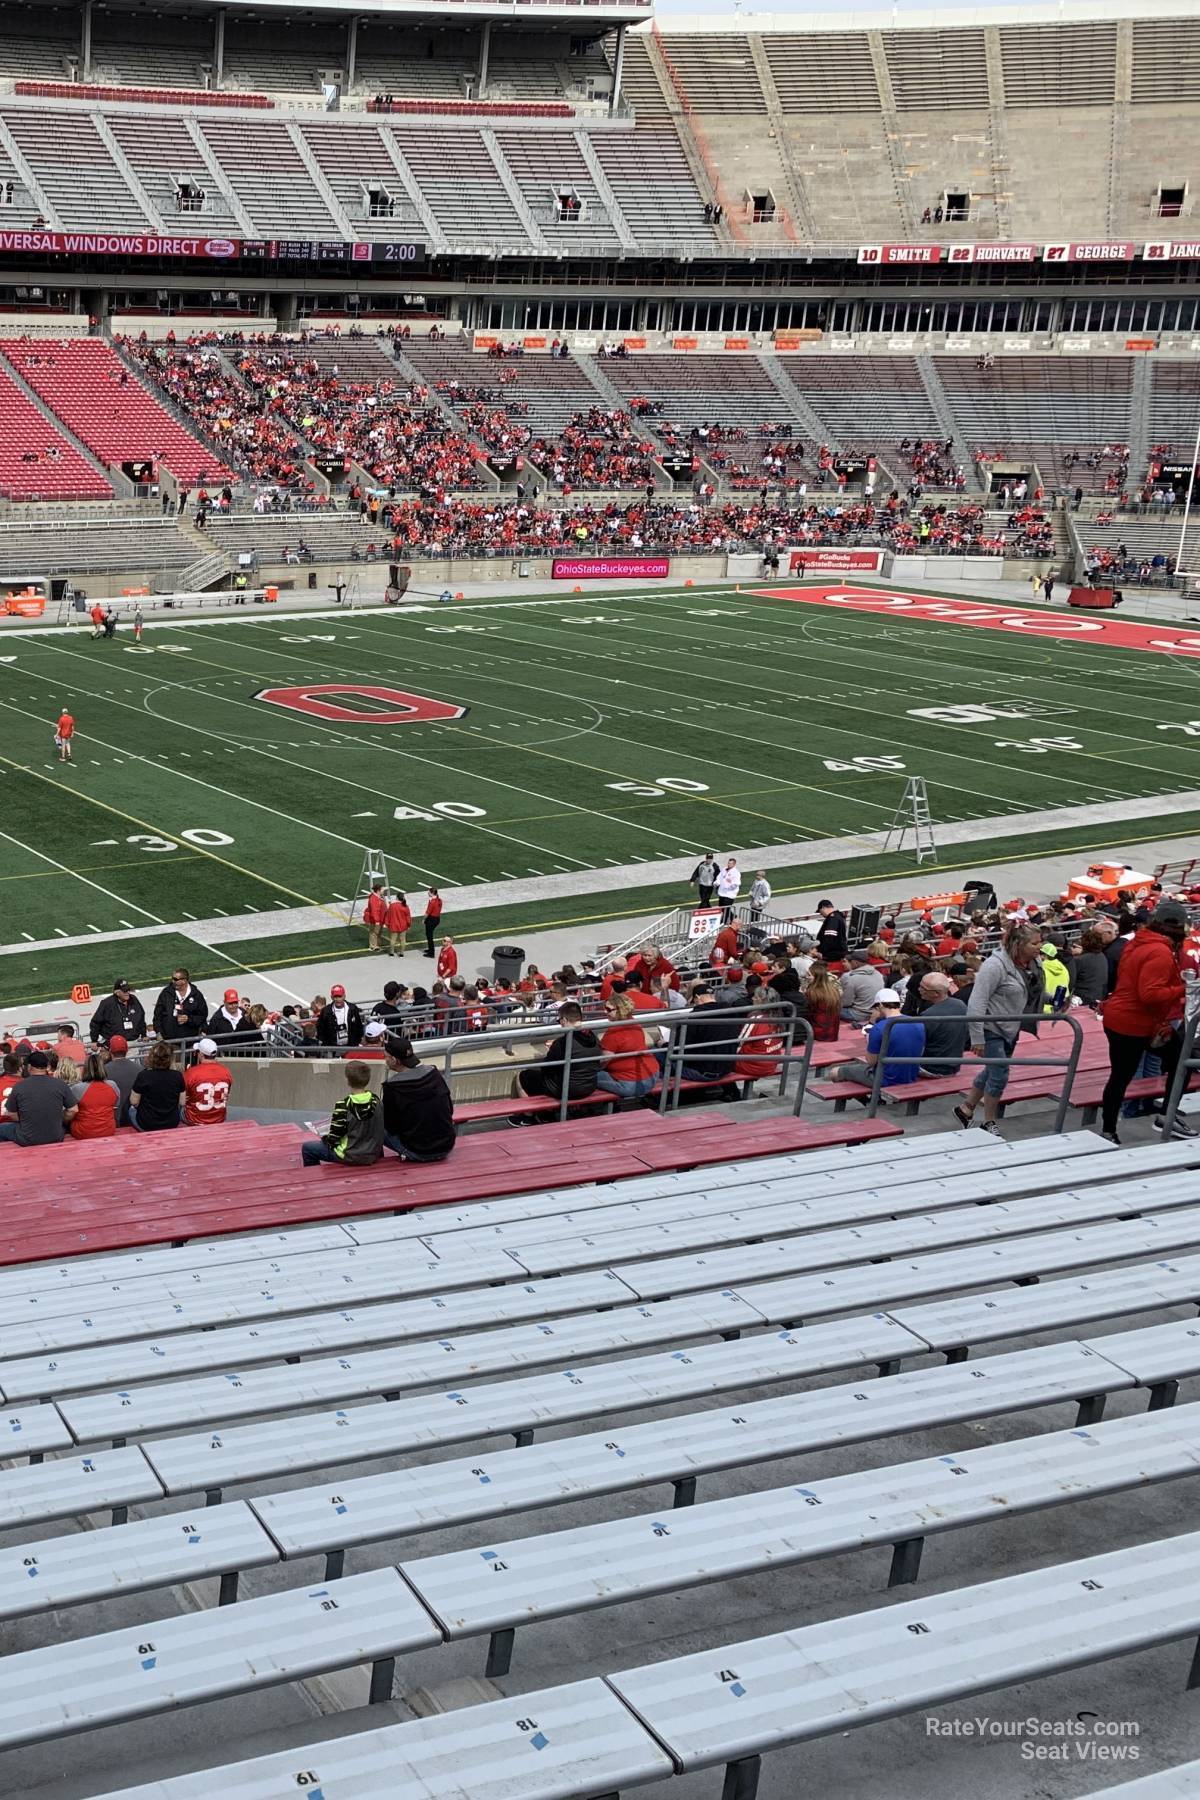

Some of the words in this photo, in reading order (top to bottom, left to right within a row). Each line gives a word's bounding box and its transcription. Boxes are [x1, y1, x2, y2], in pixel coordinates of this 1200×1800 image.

[64, 235, 143, 253] WINDOWS
[147, 238, 199, 255] DIRECT
[385, 245, 416, 260] 2:00
[862, 249, 878, 261] 10
[888, 248, 931, 261] SMITH
[952, 249, 970, 260] 22
[975, 247, 1031, 260] HORVATH
[1047, 247, 1065, 260] 27
[1075, 246, 1126, 259] GEORGE
[555, 564, 667, 575] OhioStateBuckeyes.com
[824, 594, 1106, 631] OHIO
[994, 738, 1084, 753] 30
[822, 755, 907, 773] 40
[606, 777, 710, 796] 50
[393, 801, 487, 822] 40
[125, 828, 236, 853] 30
[76, 986, 90, 1000] 20
[183, 1525, 196, 1533] 18
[495, 1562, 507, 1571] 17
[1081, 1580, 1102, 1590] 15
[322, 1600, 338, 1610] 18
[907, 1624, 929, 1634] 16
[139, 1644, 155, 1654] 19
[721, 1670, 738, 1682] 17
[516, 1719, 537, 1731] 18
[297, 1772, 317, 1785] 19
